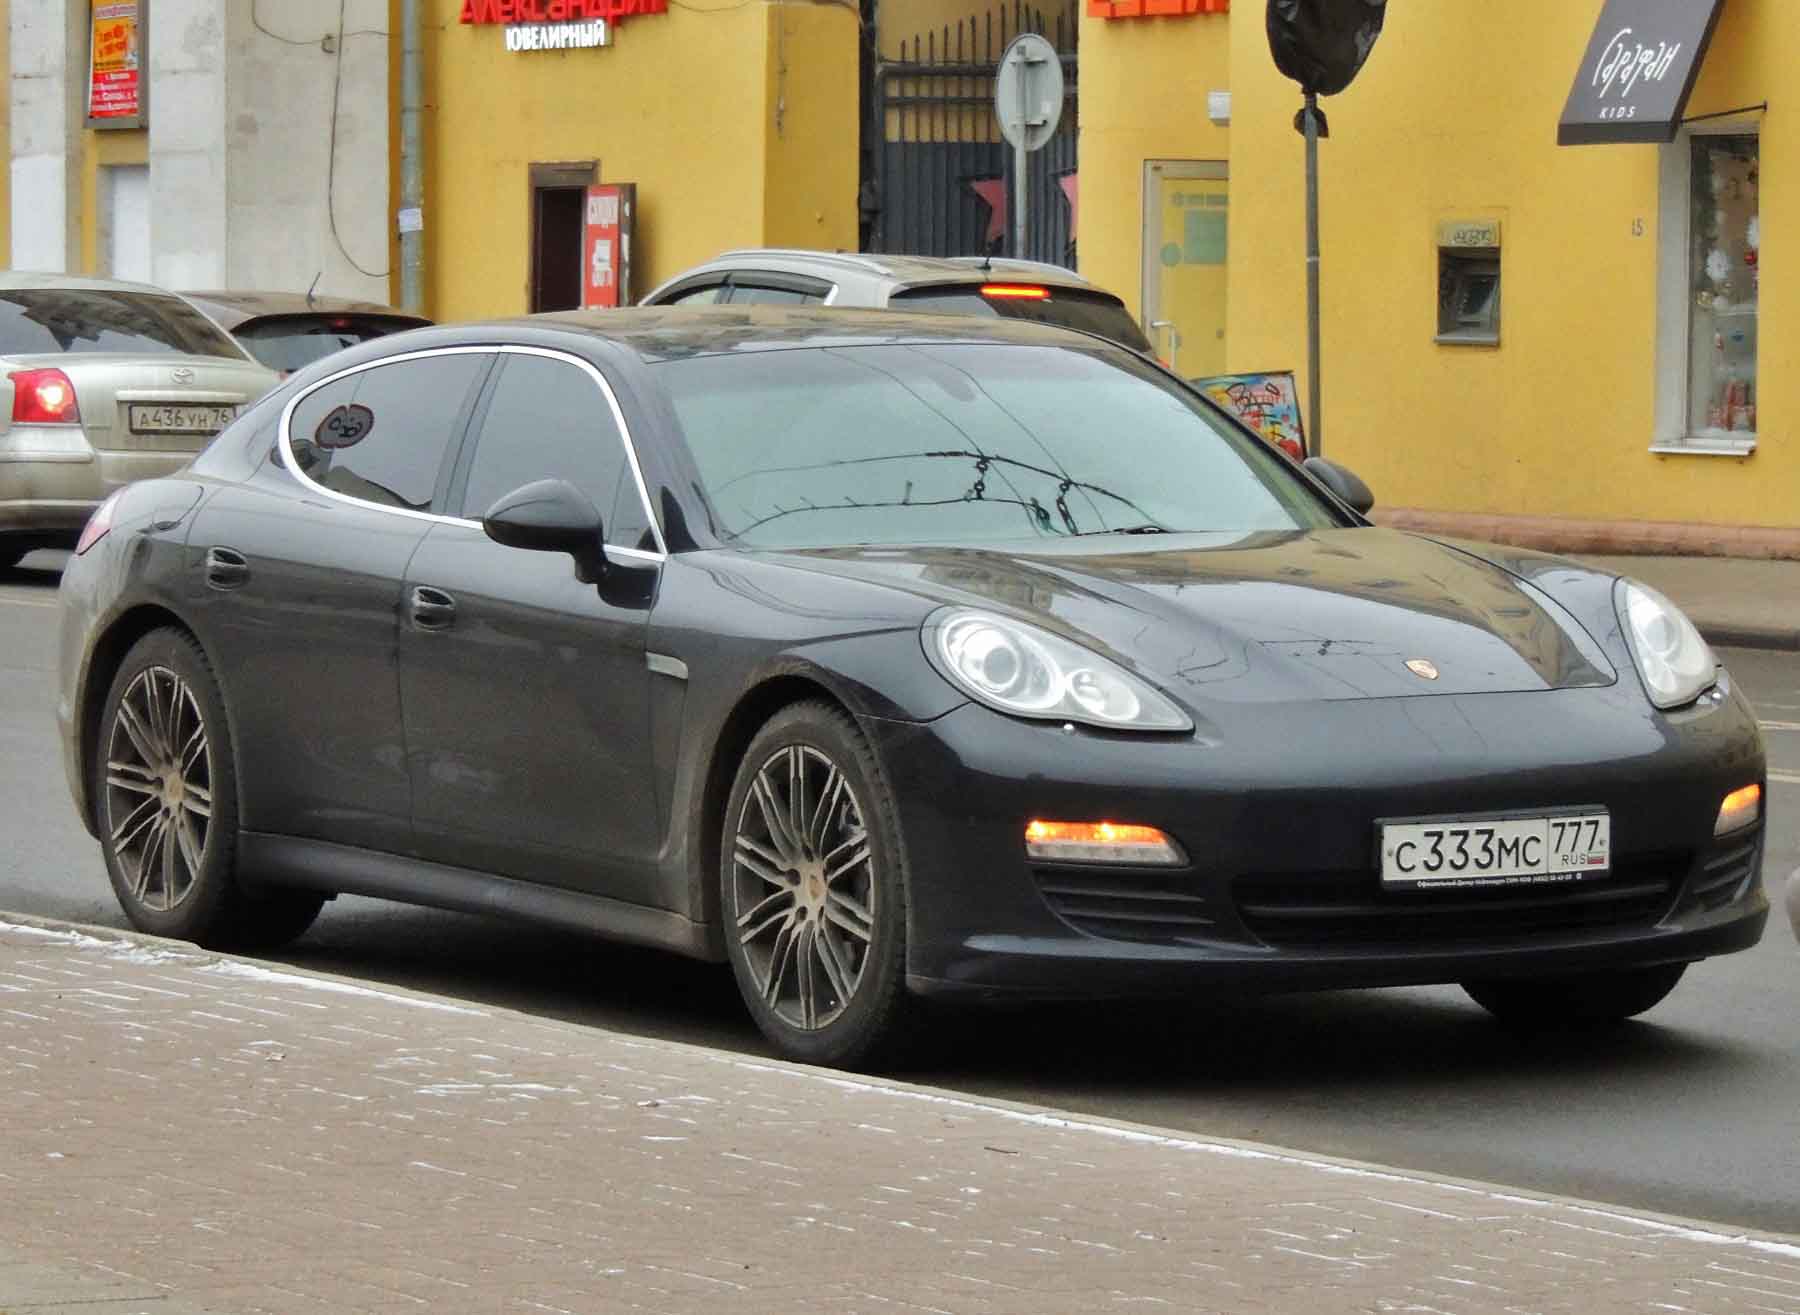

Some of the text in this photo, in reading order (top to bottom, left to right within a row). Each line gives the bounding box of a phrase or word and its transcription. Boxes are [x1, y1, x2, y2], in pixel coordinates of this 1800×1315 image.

[505, 19, 605, 51] ЮВЕЛИРНЫЙ
[1599, 106, 1637, 119] KIDS
[1396, 819, 1600, 873] С333МС 777
[1561, 854, 1586, 865] RUS
